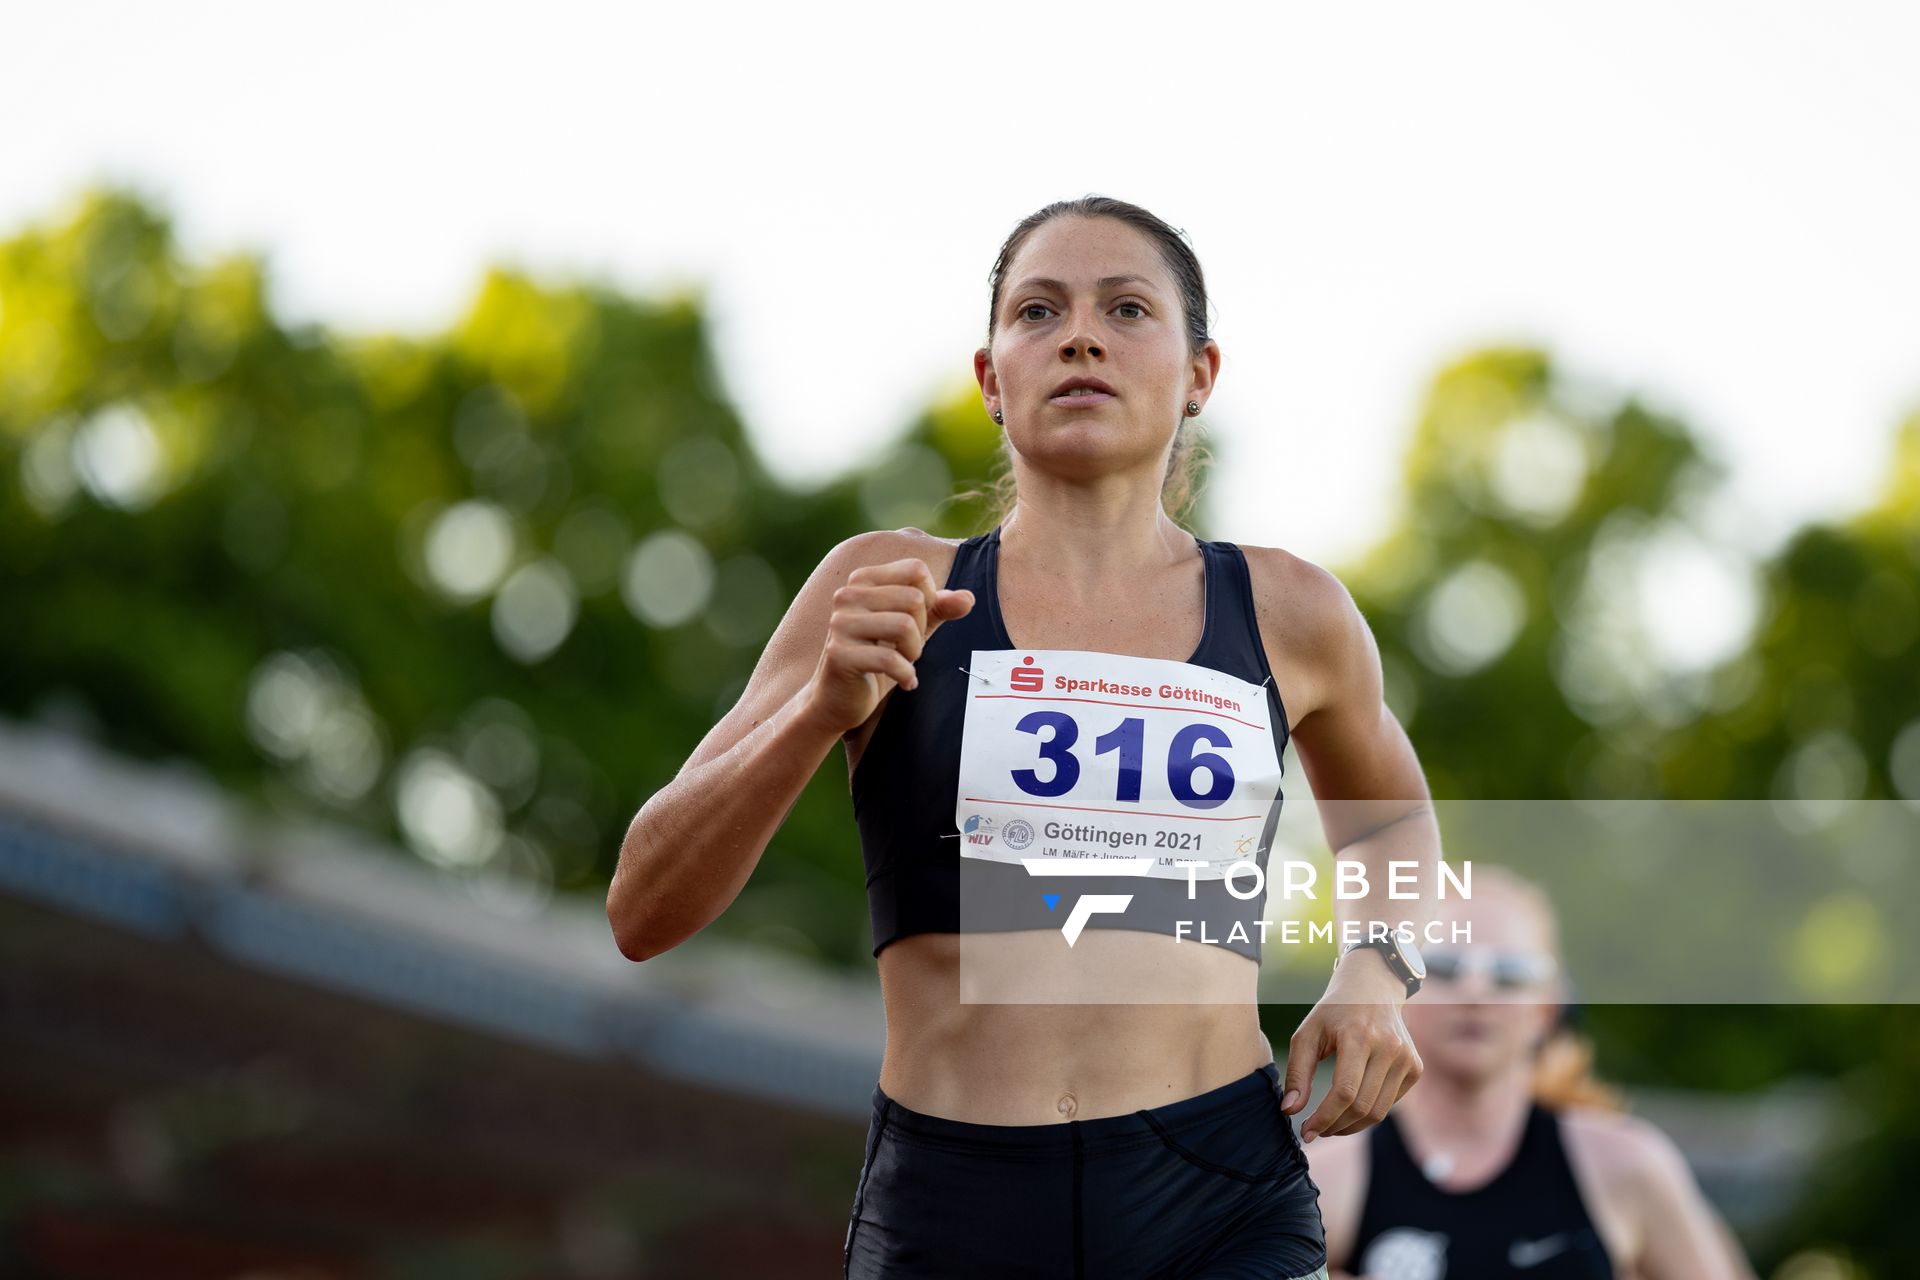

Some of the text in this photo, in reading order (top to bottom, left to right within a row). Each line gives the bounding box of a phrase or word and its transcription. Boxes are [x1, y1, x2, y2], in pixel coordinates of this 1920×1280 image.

[1055, 676, 1241, 712] Sparkasse Göttingen
[1010, 710, 1235, 809] 316
[968, 834, 994, 846] NLV
[1044, 821, 1202, 851] Göttingen 2021
[1042, 847, 1058, 856] LM
[1158, 857, 1173, 866] LM
